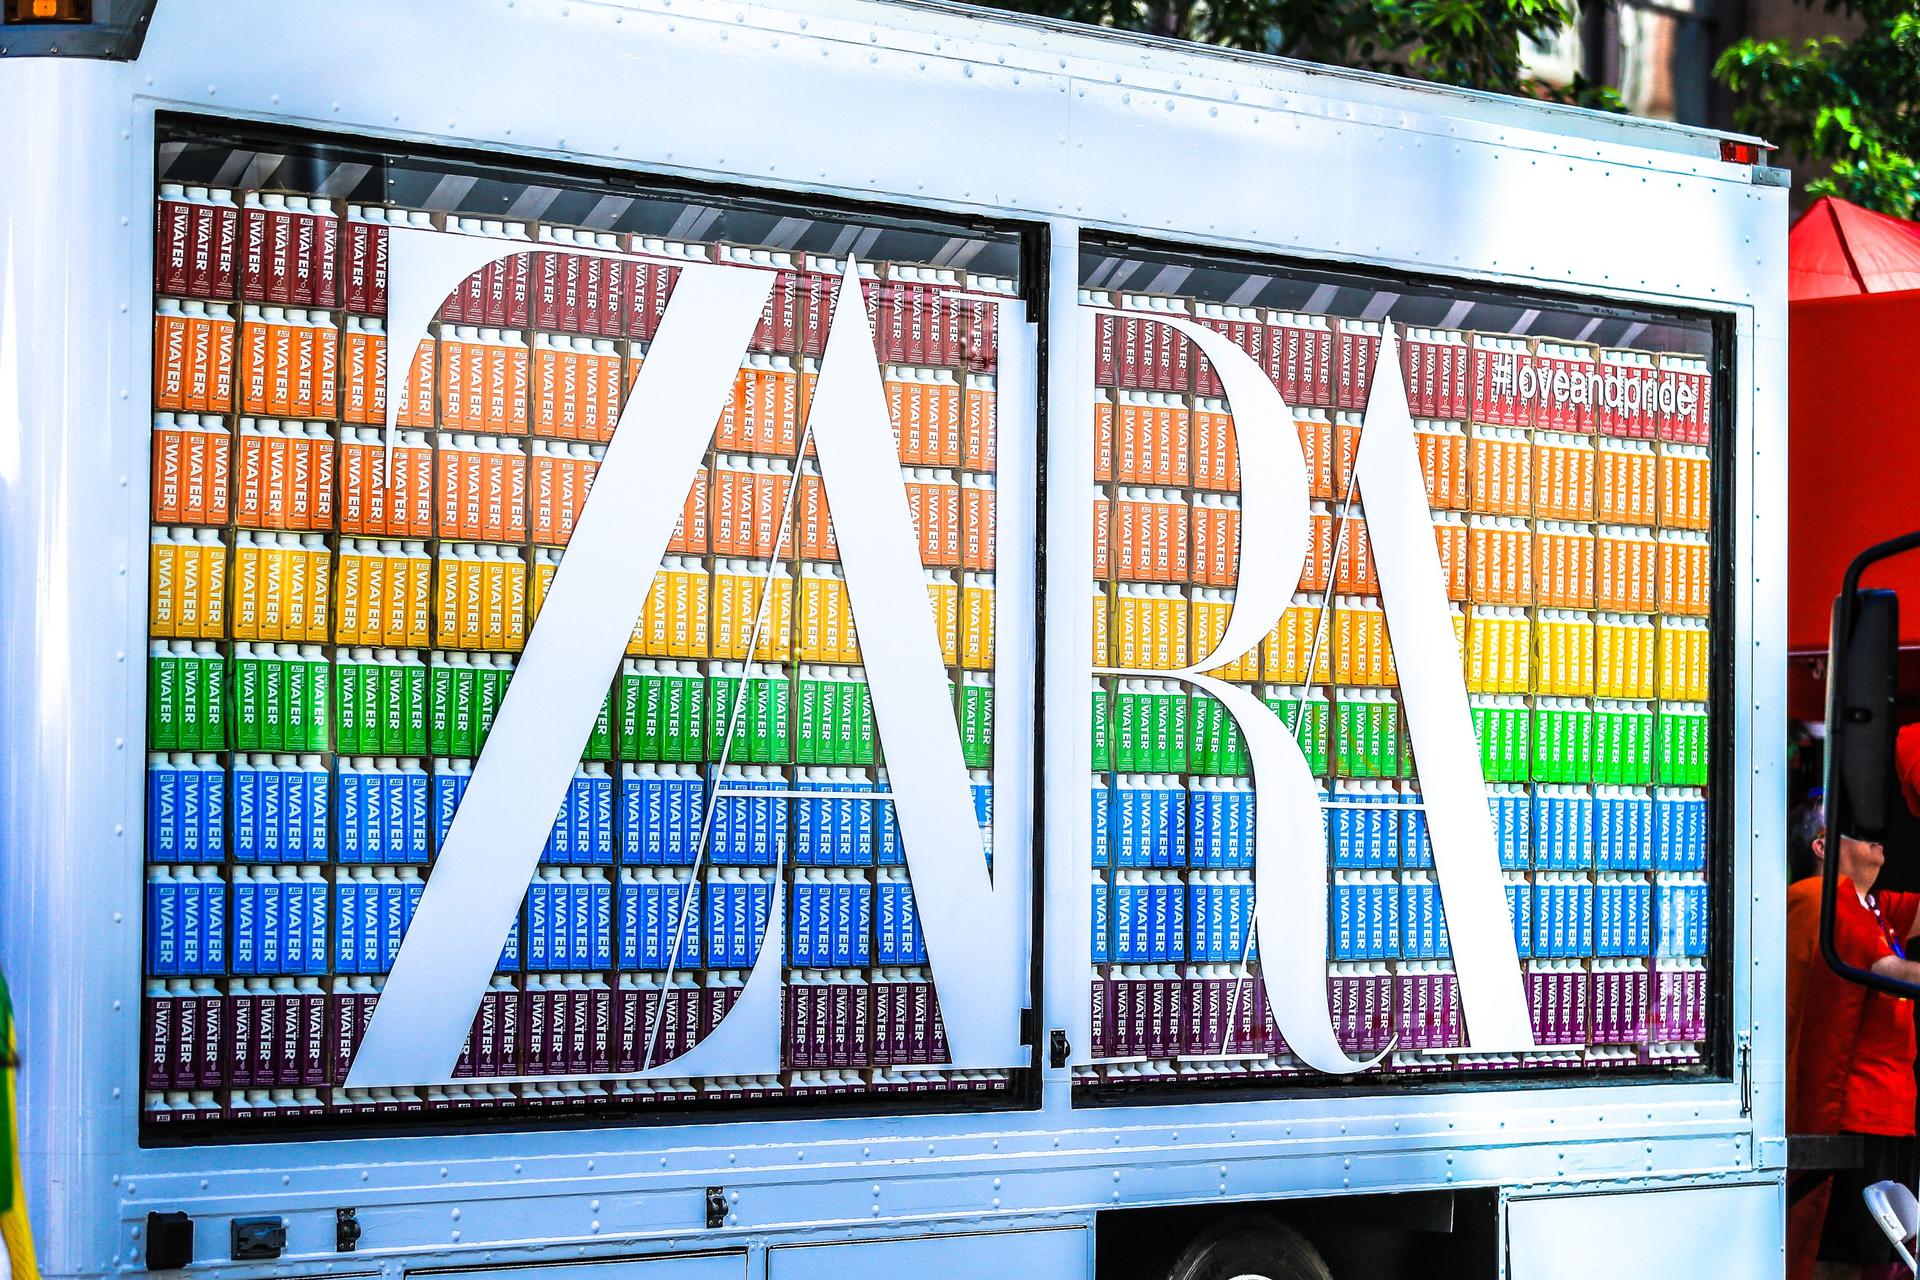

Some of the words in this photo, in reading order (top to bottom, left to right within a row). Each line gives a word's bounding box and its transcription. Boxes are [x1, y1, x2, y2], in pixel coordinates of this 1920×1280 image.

[196, 219, 208, 270] WATER
[273, 225, 285, 276] WATER
[352, 235, 363, 286] WATER
[608, 263, 618, 311] WATER
[911, 294, 923, 340] WATER
[1125, 319, 1137, 366] WATER
[194, 330, 208, 394] WATER
[252, 333, 265, 397] WATER
[322, 340, 335, 400] WATER
[449, 353, 461, 413] WATER
[514, 358, 527, 418] WATER
[1303, 339, 1314, 383] WATER
[1410, 352, 1420, 394] WATER
[1476, 359, 1486, 401] WATER
[1493, 353, 1696, 419] #loveandpride
[586, 365, 598, 425] WATER
[783, 383, 795, 439] WATER
[947, 396, 957, 456] WATER
[1159, 418, 1169, 475] WATER
[190, 445, 203, 513] WATER
[270, 450, 283, 518] WATER
[348, 456, 361, 516] WATER
[1321, 434, 1330, 488] WATER
[417, 460, 431, 520] WATER
[468, 463, 480, 523] WATER
[539, 467, 552, 527] WATER
[740, 483, 752, 540] WATER
[927, 494, 939, 555] WATER
[1140, 513, 1150, 570] WATER
[1215, 519, 1225, 576] WATER
[158, 558, 171, 626] WATER
[243, 561, 255, 629] WATER
[314, 565, 326, 633] WATER
[392, 572, 404, 636] WATER
[468, 574, 479, 639] WATER
[721, 590, 734, 641] WATER
[807, 589, 818, 646] WATER
[969, 598, 980, 654] WATER
[1124, 607, 1134, 661] WATER
[1175, 610, 1186, 663] WATER
[1372, 622, 1382, 672] WATER
[343, 226, 1585, 1087] ZARA
[184, 671, 196, 724] WATER
[267, 672, 278, 726] WATER
[343, 678, 353, 728] WATER
[411, 679, 422, 729] WATER
[625, 688, 638, 735] WATER
[690, 690, 703, 737] WATER
[776, 691, 787, 737] WATER
[842, 695, 854, 739] WATER
[1157, 706, 1168, 750] WATER
[1304, 712, 1313, 753] WATER
[1372, 712, 1381, 757] WATER
[1519, 718, 1528, 761] WATER
[1582, 721, 1590, 764] WATER
[1643, 724, 1652, 764] WATER
[160, 775, 174, 783] JUST
[184, 775, 199, 783] JUST
[265, 776, 278, 784] JUST
[344, 778, 357, 786] JUST
[159, 784, 174, 849] WATER
[239, 784, 254, 849] WATER
[314, 786, 326, 849] WATER
[390, 788, 403, 850] WATER
[578, 792, 590, 852] WATER
[649, 793, 660, 853] WATER
[1096, 800, 1107, 855] WATER
[1159, 801, 1168, 856] WATER
[1229, 802, 1239, 858] WATER
[1555, 808, 1563, 860] WATER
[1615, 810, 1624, 859] WATER
[1675, 811, 1684, 861] WATER
[184, 897, 198, 962] WATER
[265, 898, 278, 961] WATER
[342, 897, 354, 961] WATER
[554, 896, 567, 958] WATER
[626, 897, 637, 957] WATER
[734, 896, 745, 956] WATER
[839, 897, 849, 954] WATER
[902, 896, 913, 953] WATER
[1136, 896, 1149, 952] WATER
[1212, 896, 1223, 951] WATER
[1372, 896, 1383, 948] WATER
[1521, 895, 1530, 947] WATER
[1568, 895, 1577, 947] WATER
[1628, 895, 1637, 947] WATER
[531, 1001, 542, 1053] WATER
[595, 999, 607, 1051] WATER
[836, 995, 847, 1044] WATER
[896, 993, 906, 1042] WATER
[1118, 990, 1127, 1037] WATER
[1192, 989, 1202, 1036] WATER
[1348, 987, 1358, 1031] WATER
[1418, 984, 1427, 1028] WATER
[1548, 983, 1557, 1024] WATER
[1611, 982, 1619, 1023] WATER
[205, 1006, 219, 1062] WATER
[259, 1005, 272, 1061] WATER
[339, 1005, 352, 1057] WATER
